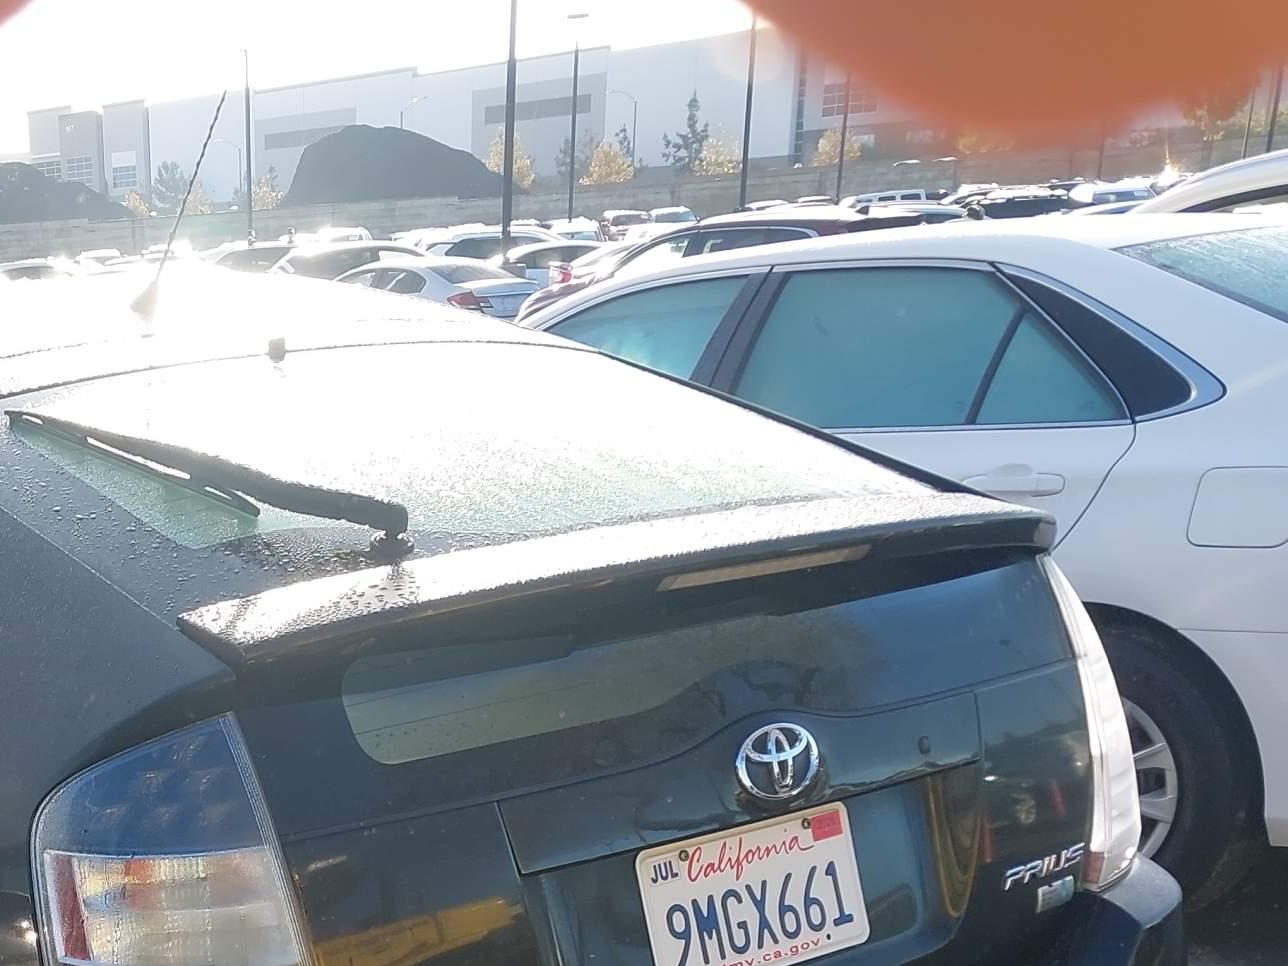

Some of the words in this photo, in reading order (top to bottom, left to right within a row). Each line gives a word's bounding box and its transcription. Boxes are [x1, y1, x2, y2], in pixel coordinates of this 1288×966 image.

[650, 859, 679, 884] JUL
[686, 836, 815, 882] California
[1004, 842, 1085, 890] PRIUS
